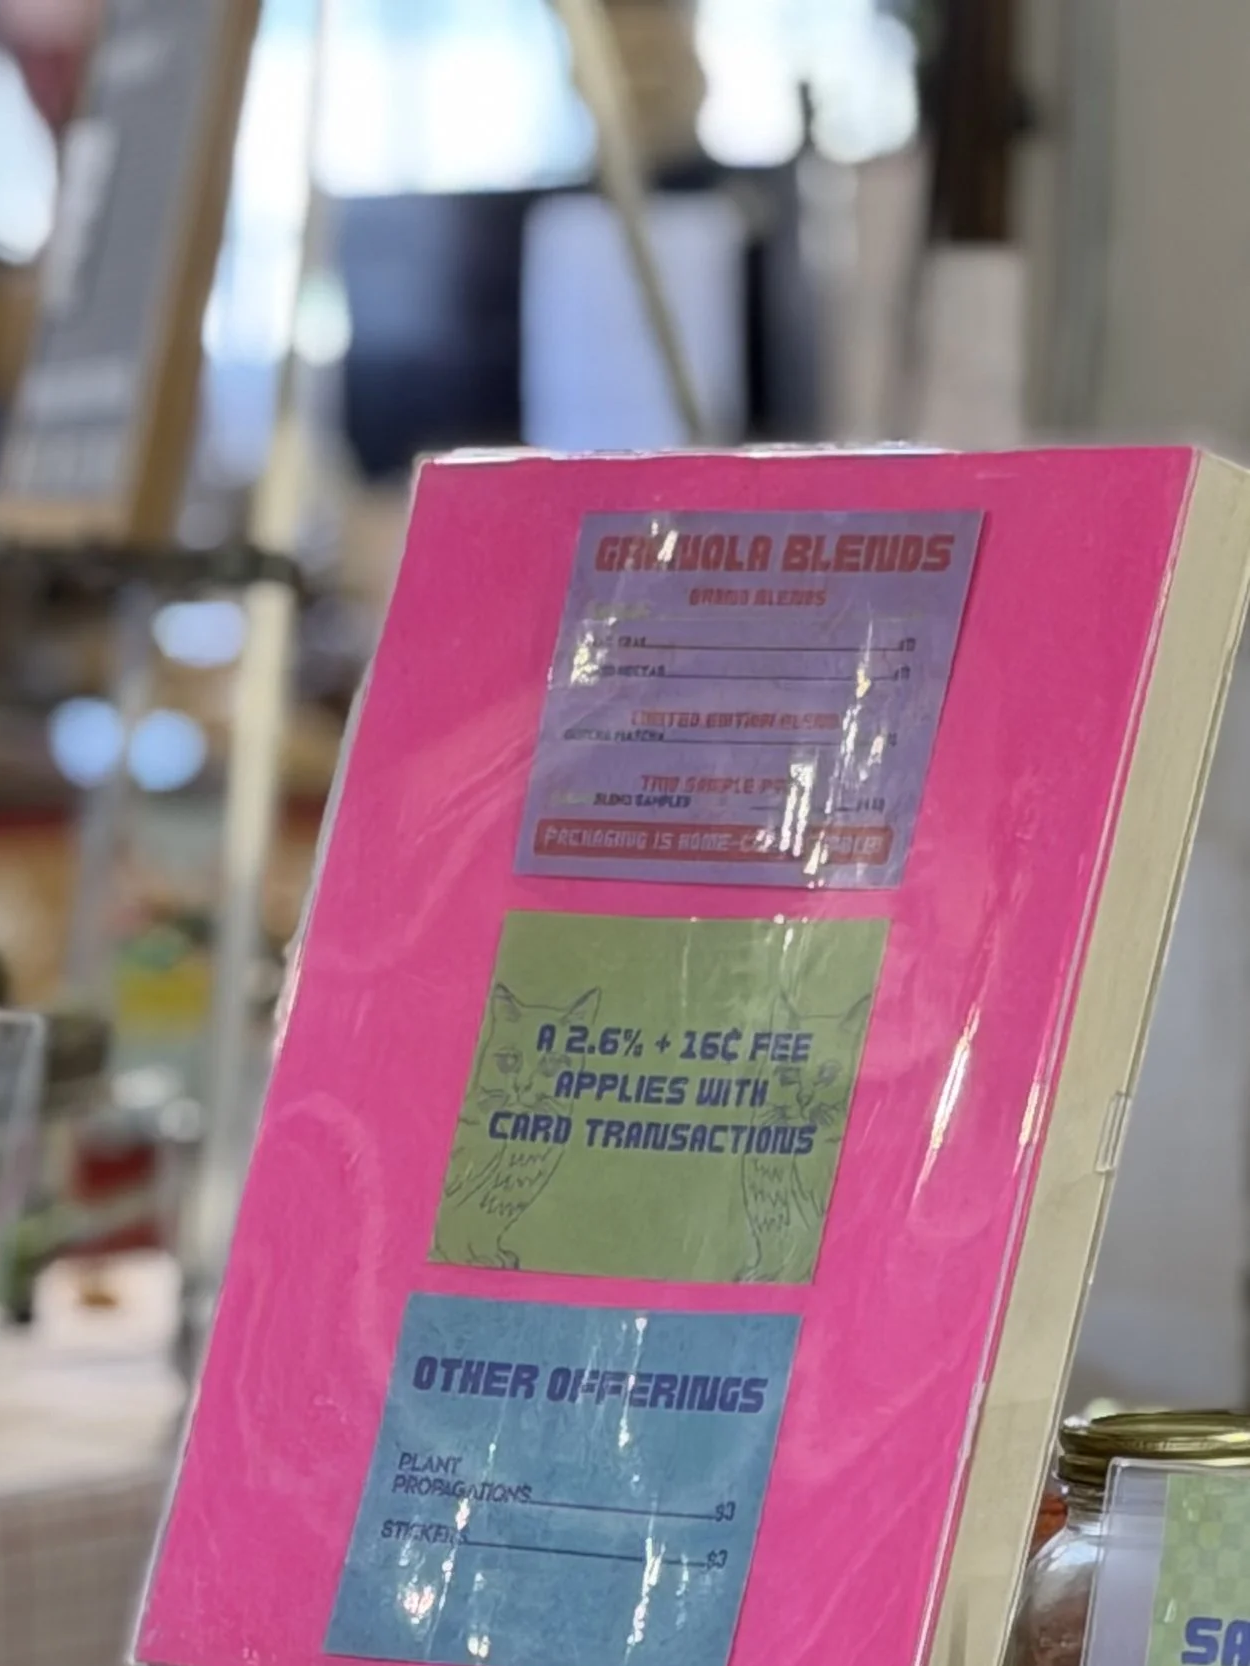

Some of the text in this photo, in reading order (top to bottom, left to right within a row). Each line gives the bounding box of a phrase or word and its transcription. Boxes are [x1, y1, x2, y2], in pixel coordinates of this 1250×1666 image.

[595, 533, 955, 573] GRANOLA BLENDS
[652, 831, 674, 850] IS
[536, 1022, 556, 1052] A
[565, 1025, 644, 1058] 2.6%
[654, 1034, 672, 1053] +
[748, 1032, 814, 1063] FEE
[554, 1070, 769, 1108] APPLIES WITH
[488, 1110, 817, 1155] CARD TRANSACTIONS
[412, 1355, 769, 1414] OTHER OFFERINGS
[398, 1451, 463, 1475] PLANT
[391, 1473, 533, 1504] PROPAGATIONS
